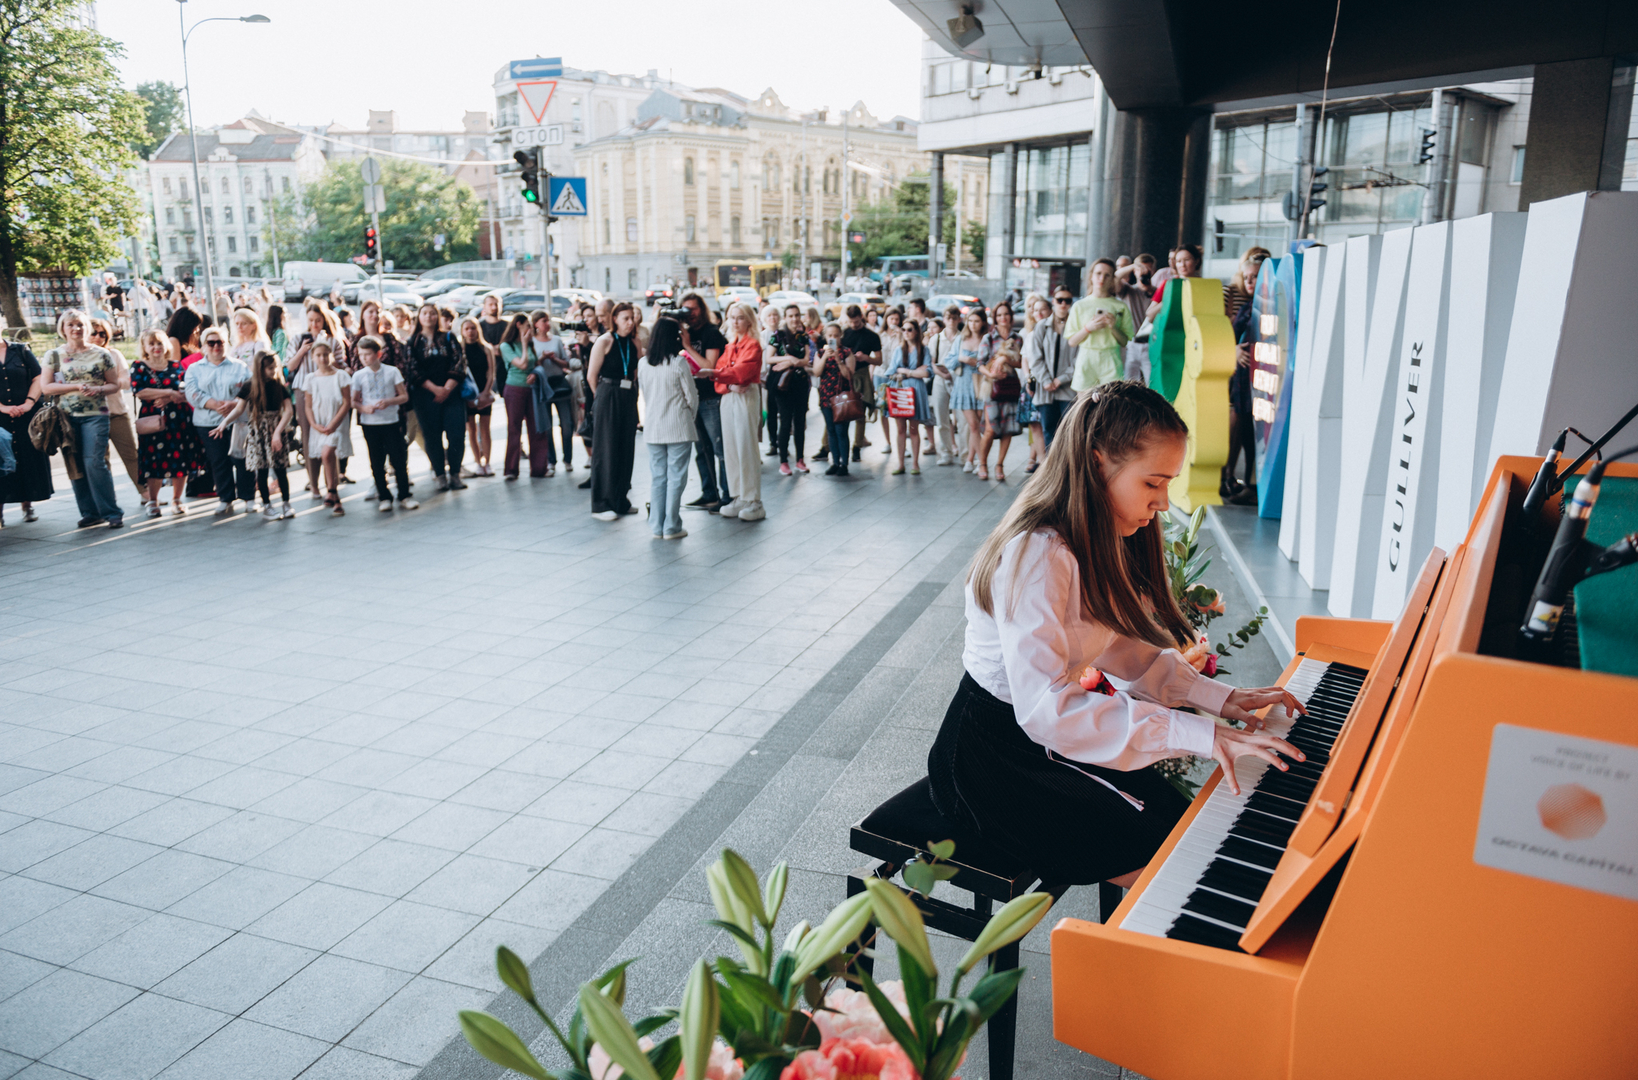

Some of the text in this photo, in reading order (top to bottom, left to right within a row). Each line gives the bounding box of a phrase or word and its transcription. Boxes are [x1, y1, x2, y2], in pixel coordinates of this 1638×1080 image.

[515, 127, 559, 144] СТОП
[1389, 340, 1424, 573] GULLIVER
[1491, 836, 1559, 858] OCTAVA
